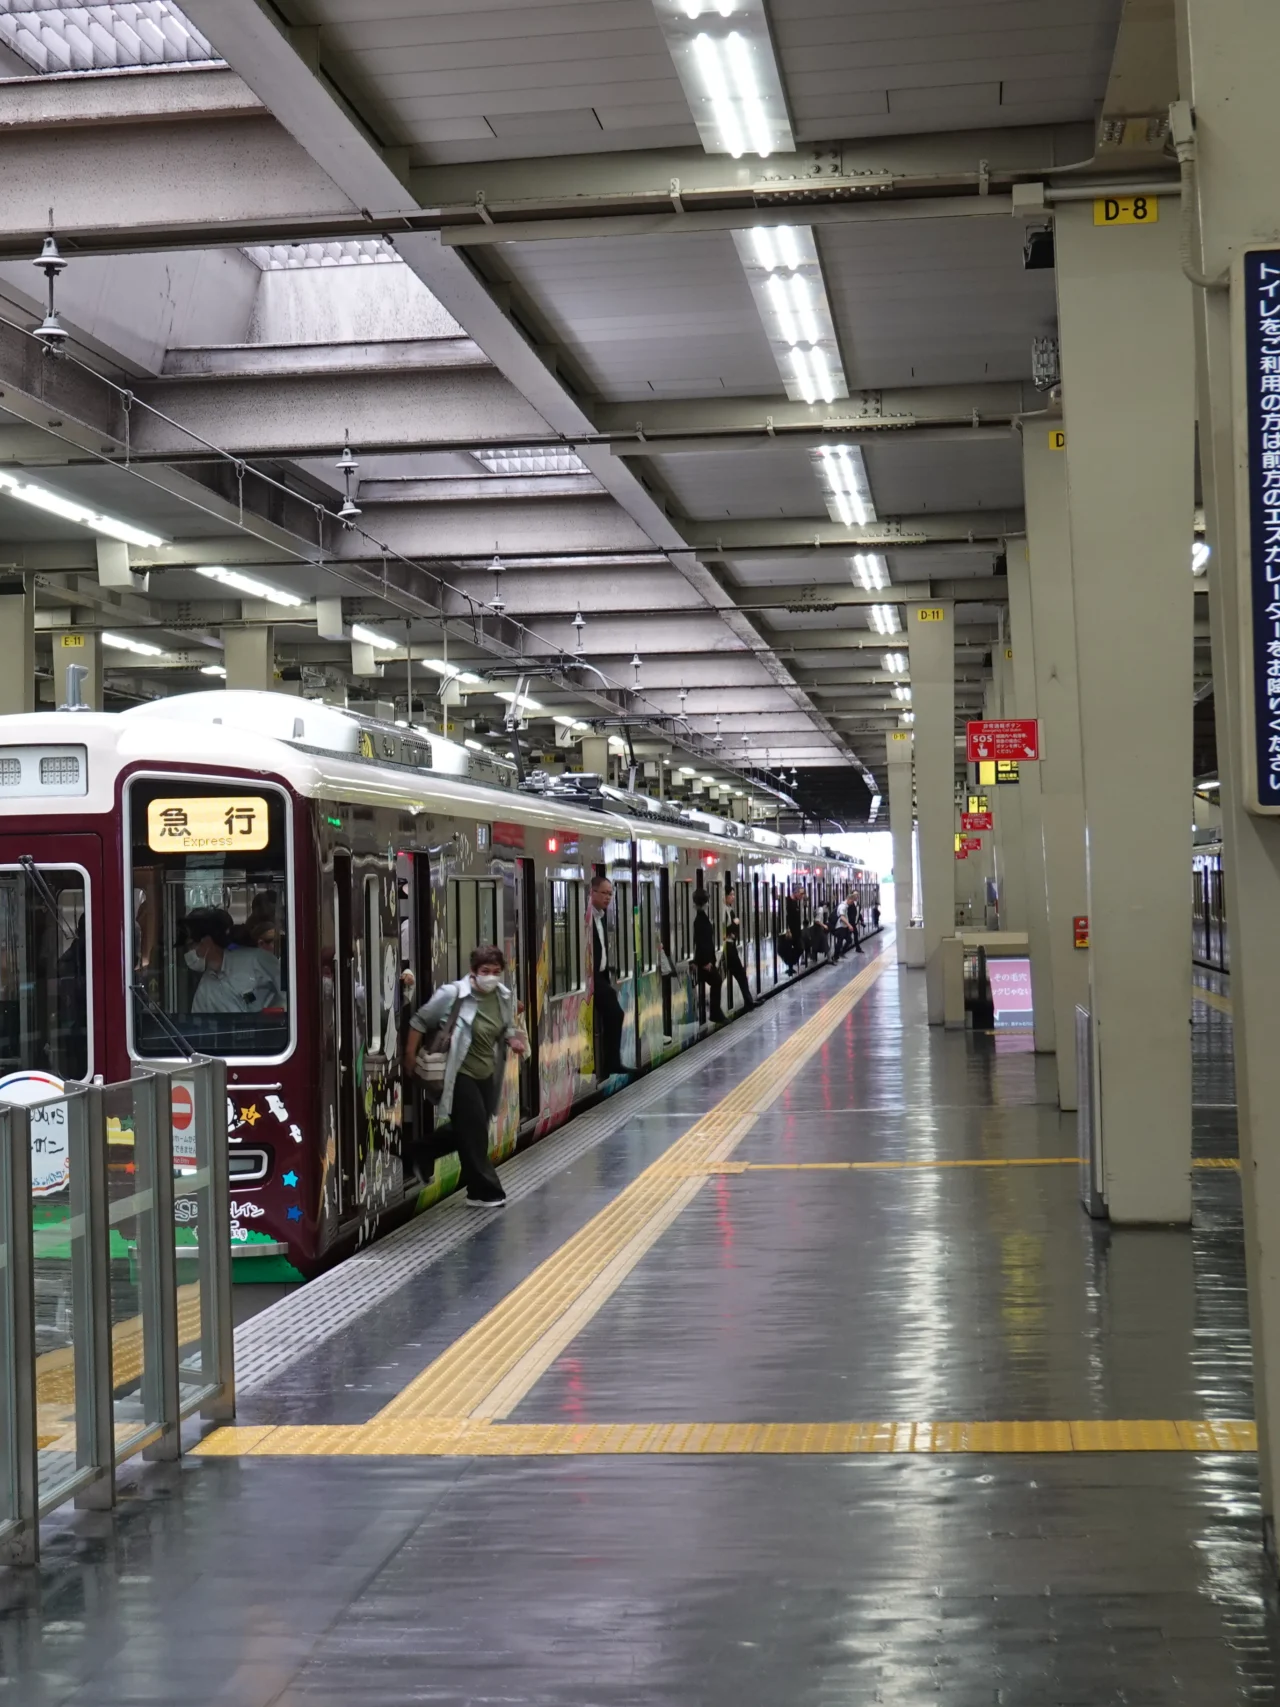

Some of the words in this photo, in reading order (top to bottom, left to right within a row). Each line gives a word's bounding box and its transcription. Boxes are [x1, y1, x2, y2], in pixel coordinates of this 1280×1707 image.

[1104, 197, 1148, 221] D-8
[921, 610, 940, 620] D-11
[64, 636, 81, 646] E-11
[972, 735, 993, 743] SOS
[159, 806, 256, 837] 急行
[183, 837, 233, 847] Express
